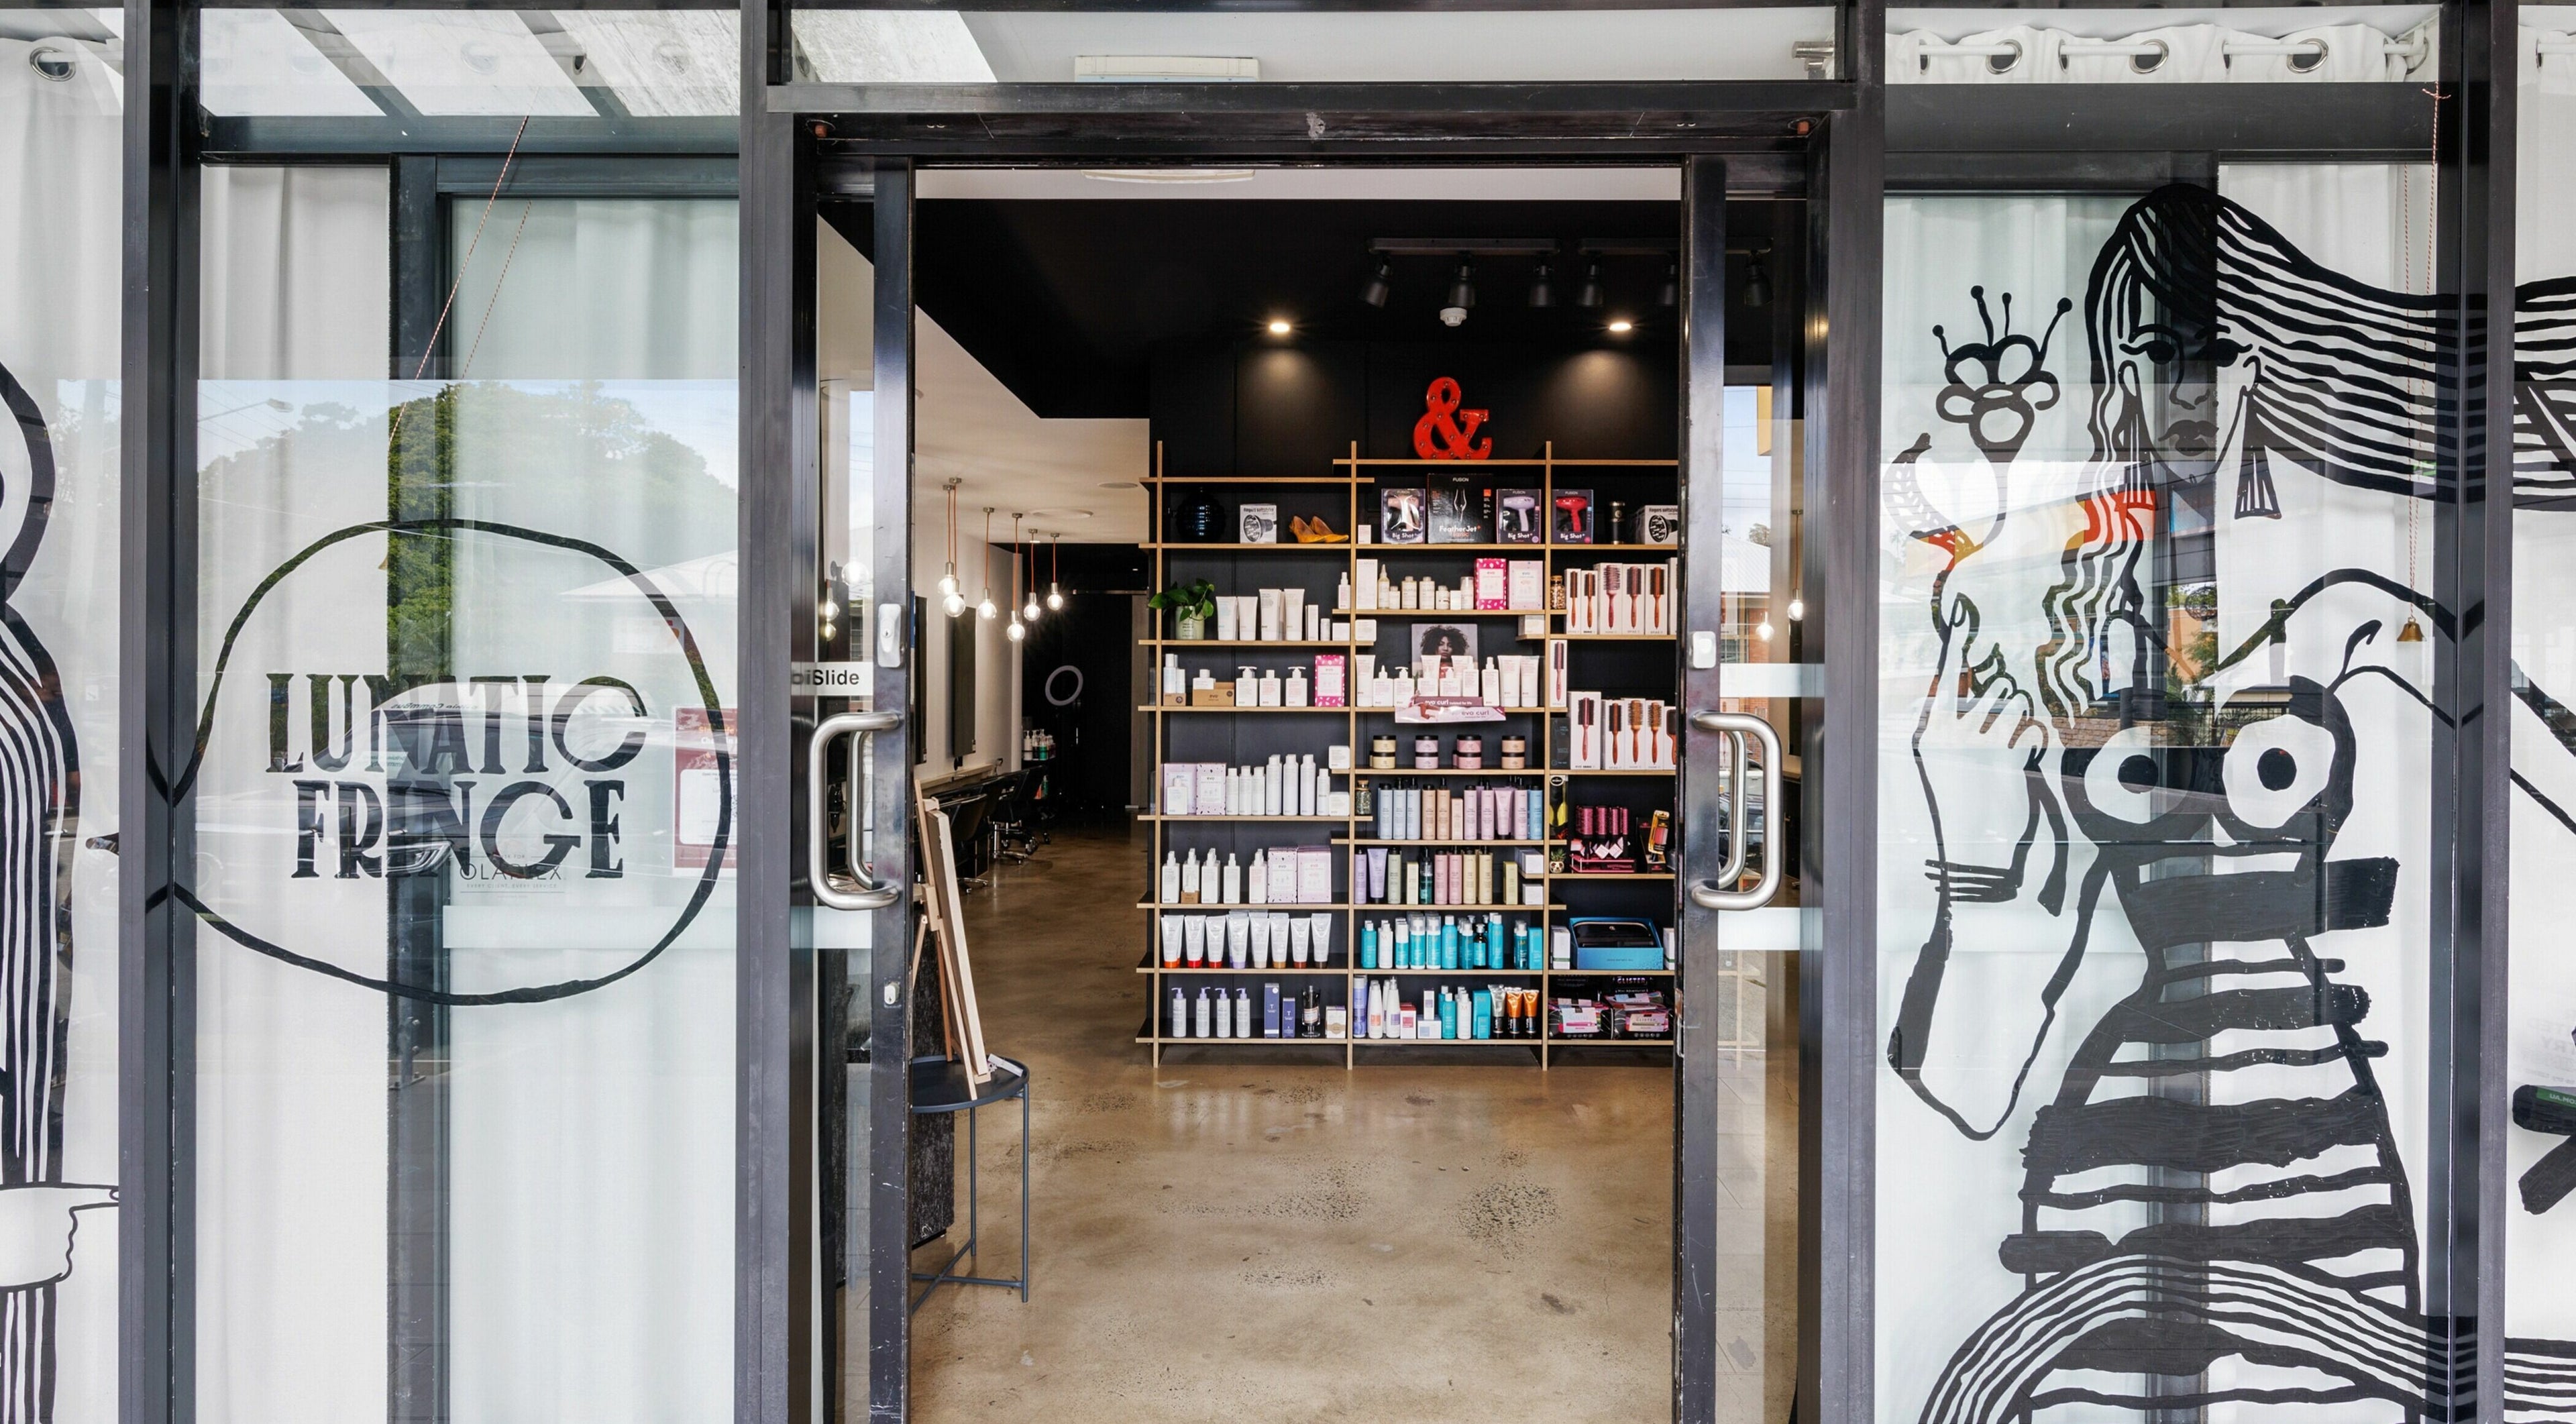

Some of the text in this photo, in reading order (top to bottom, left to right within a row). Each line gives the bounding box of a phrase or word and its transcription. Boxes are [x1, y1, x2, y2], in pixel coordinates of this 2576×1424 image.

[1413, 377, 1493, 460] &
[266, 673, 647, 775] LUNATIC
[290, 779, 626, 879] FRINGE
[460, 863, 561, 880] OLAX
